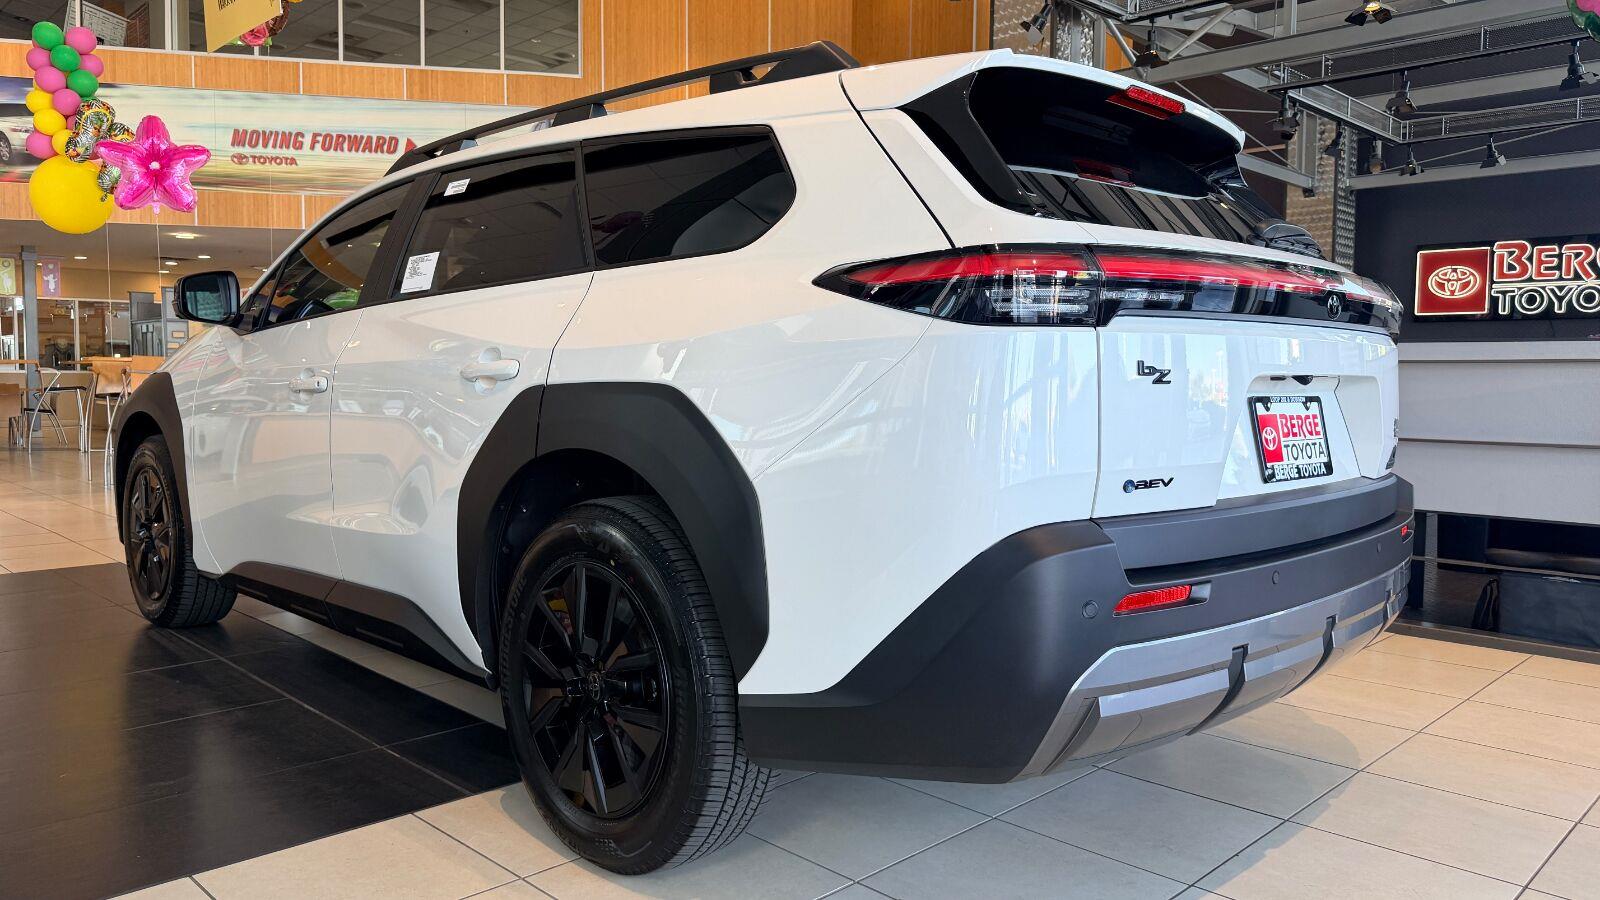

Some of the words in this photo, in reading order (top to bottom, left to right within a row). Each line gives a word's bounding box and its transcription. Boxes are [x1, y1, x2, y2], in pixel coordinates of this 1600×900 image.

[231, 128, 305, 151] MOVING
[309, 132, 399, 155] FORWARD
[250, 154, 299, 167] TOYOTA
[1493, 240, 1600, 282] BER
[1278, 413, 1322, 439] BERGE
[1283, 441, 1327, 462] TOYOTA
[1273, 464, 1299, 480] BERGE
[1299, 462, 1327, 477] TOYOTA
[1134, 477, 1175, 490] BEV
